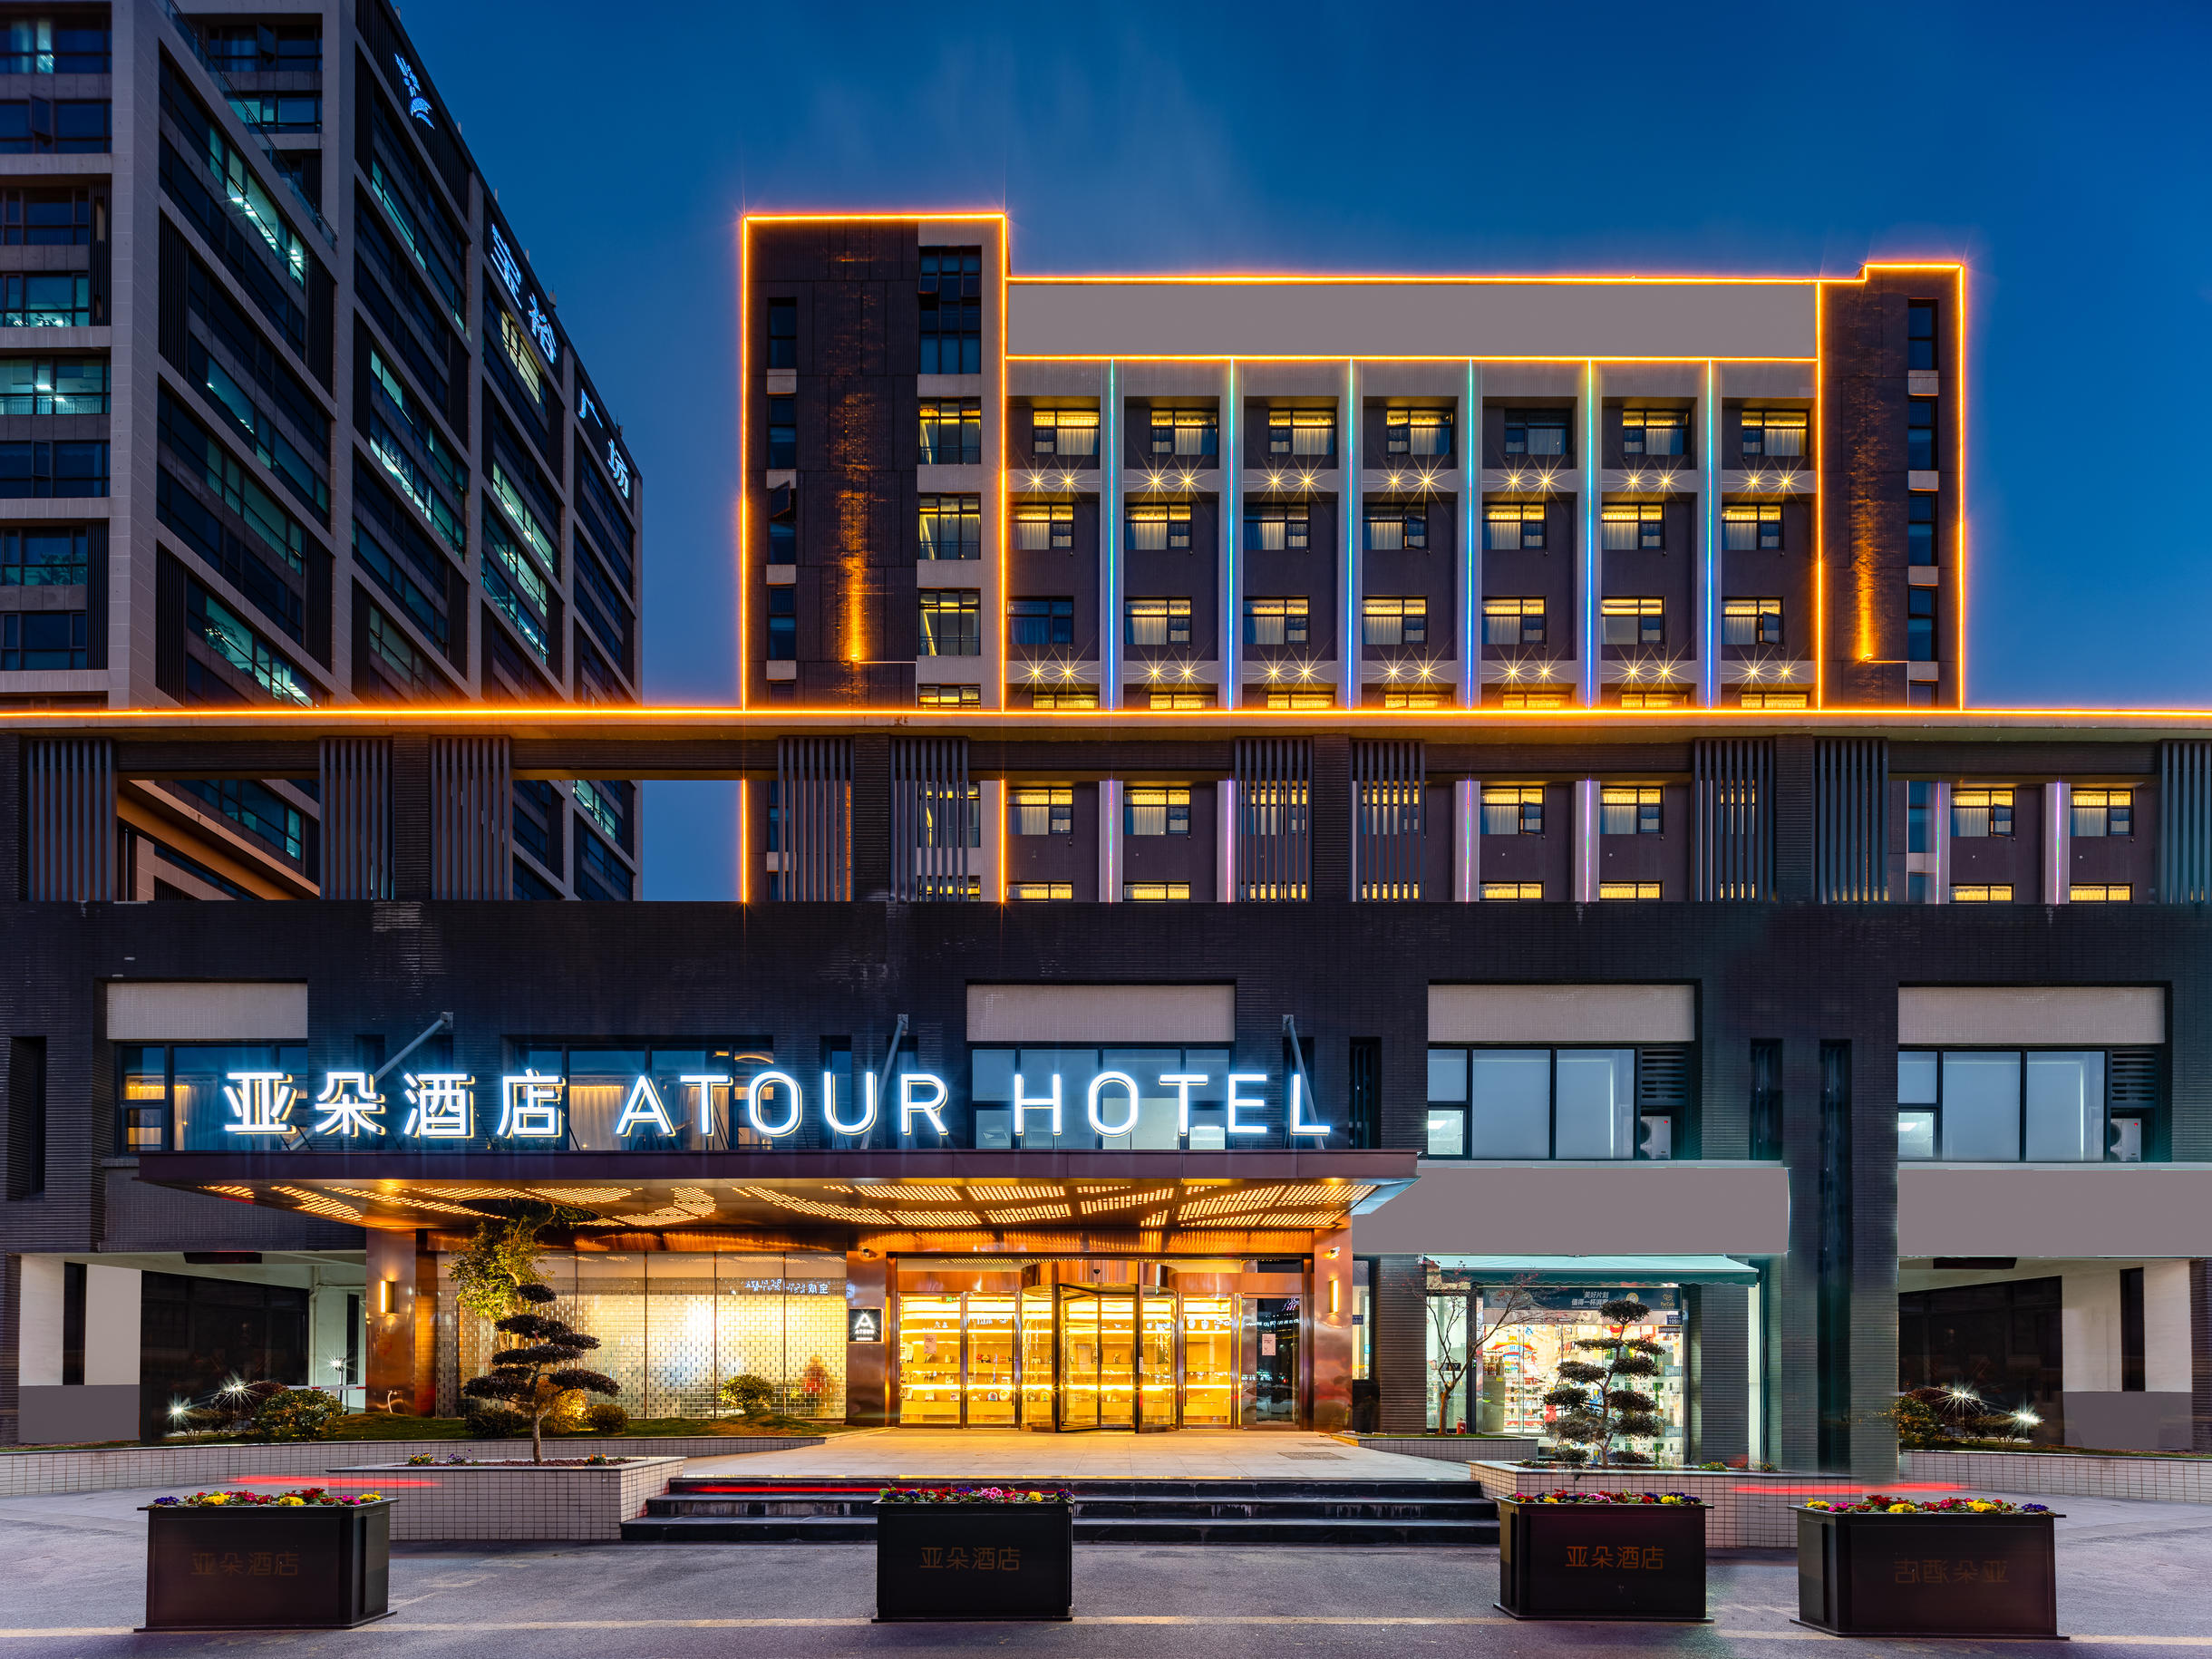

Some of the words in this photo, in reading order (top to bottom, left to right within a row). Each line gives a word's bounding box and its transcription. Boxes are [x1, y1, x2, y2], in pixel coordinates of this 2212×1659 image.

[490, 223, 629, 499] 宝裕广场
[223, 1069, 566, 1139] 亚朵酒店
[616, 1070, 948, 1138] ATOUR
[1013, 1070, 1331, 1138] HOTEL
[189, 1550, 298, 1577] 亚朵酒店
[920, 1546, 1021, 1571] 亚朵酒店
[1565, 1546, 1665, 1569] 亚朵酒店
